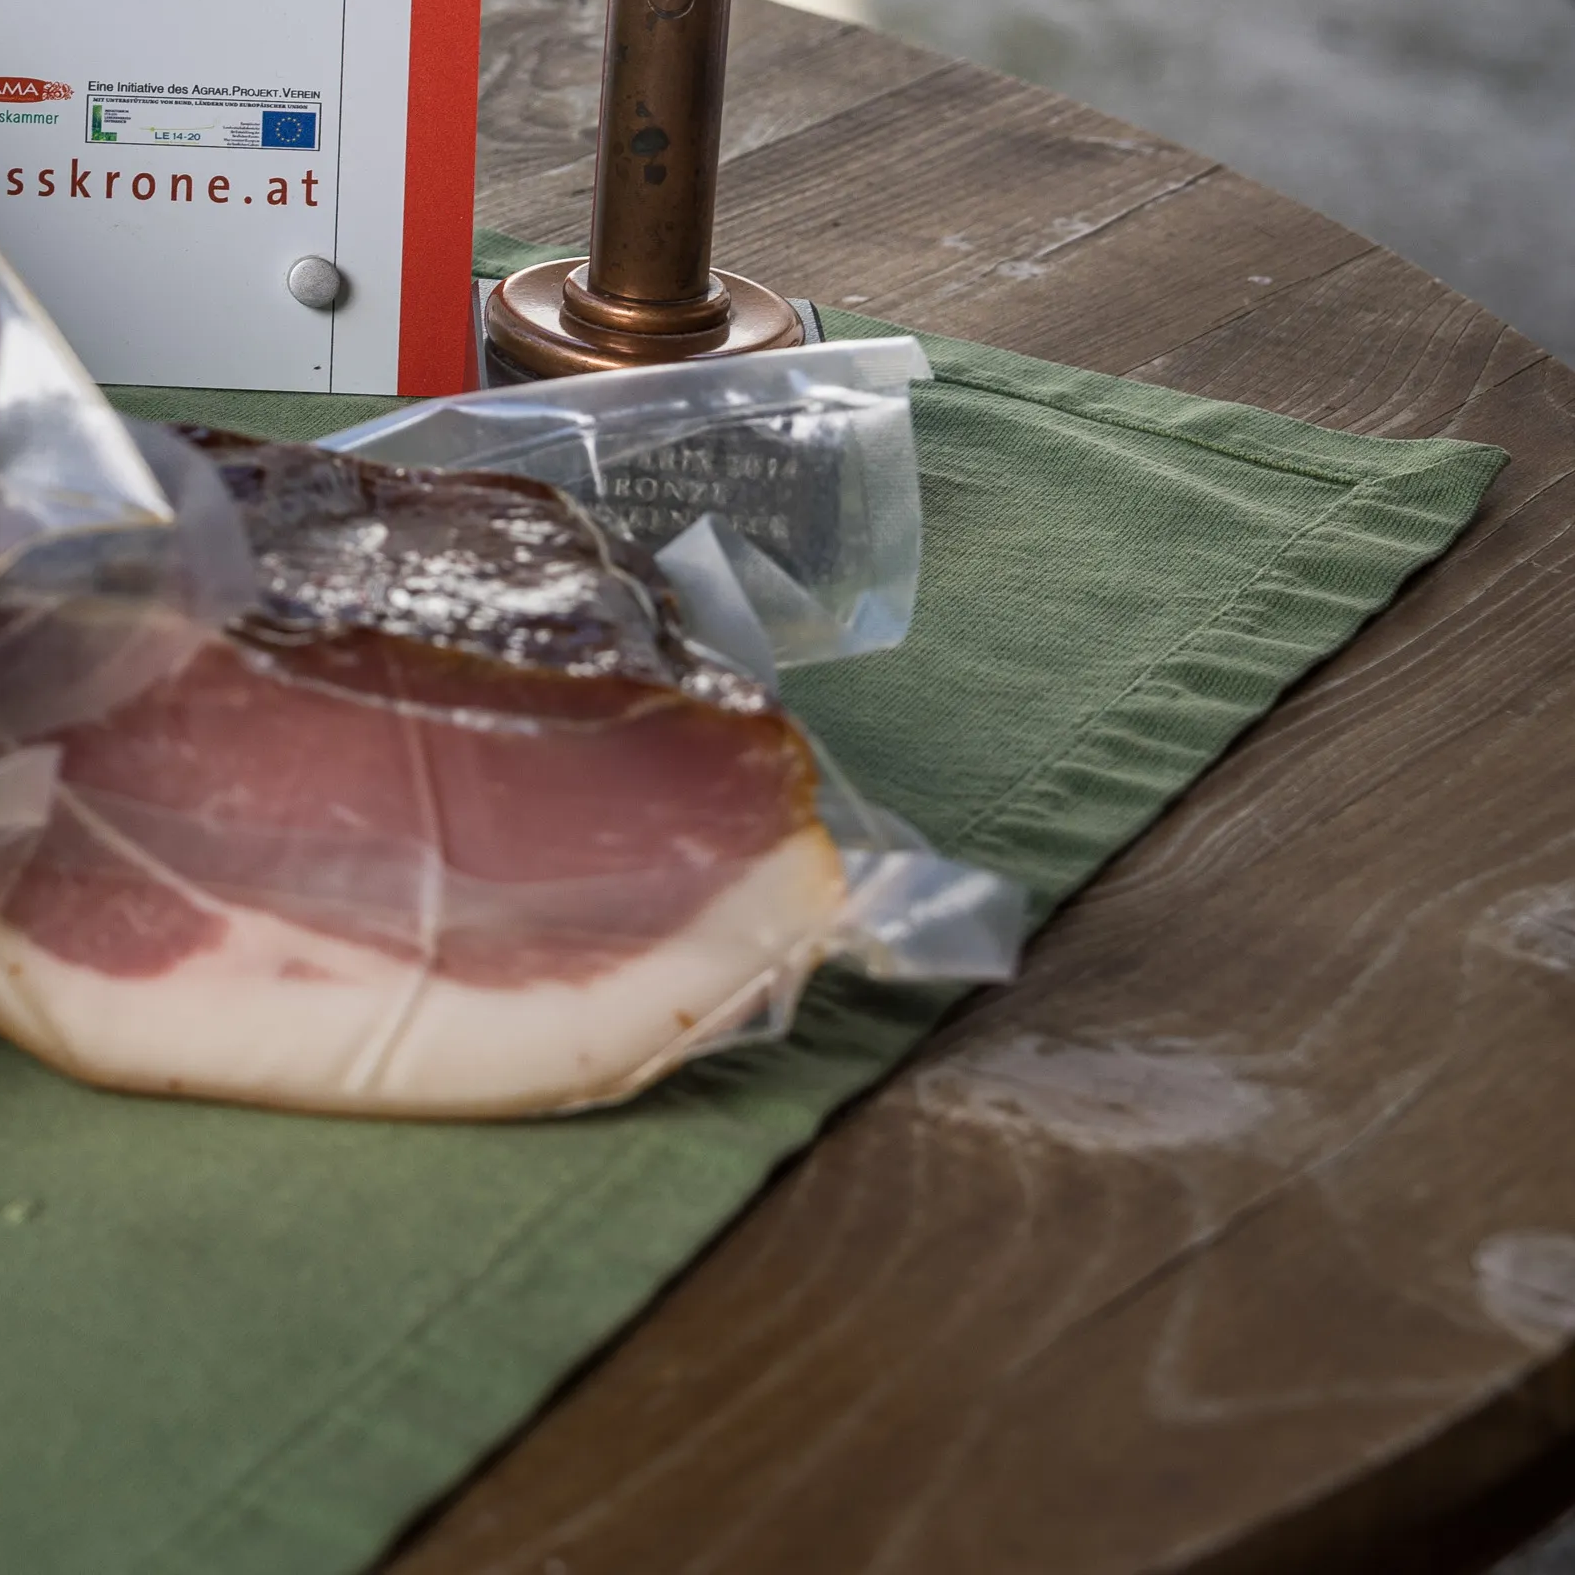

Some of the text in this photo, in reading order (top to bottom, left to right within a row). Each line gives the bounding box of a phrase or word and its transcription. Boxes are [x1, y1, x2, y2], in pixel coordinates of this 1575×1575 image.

[87, 80, 114, 92] Eine
[116, 81, 165, 94] Initiative
[167, 83, 189, 94] des
[154, 131, 201, 141] LE 14-20
[598, 476, 729, 505] RONZE
